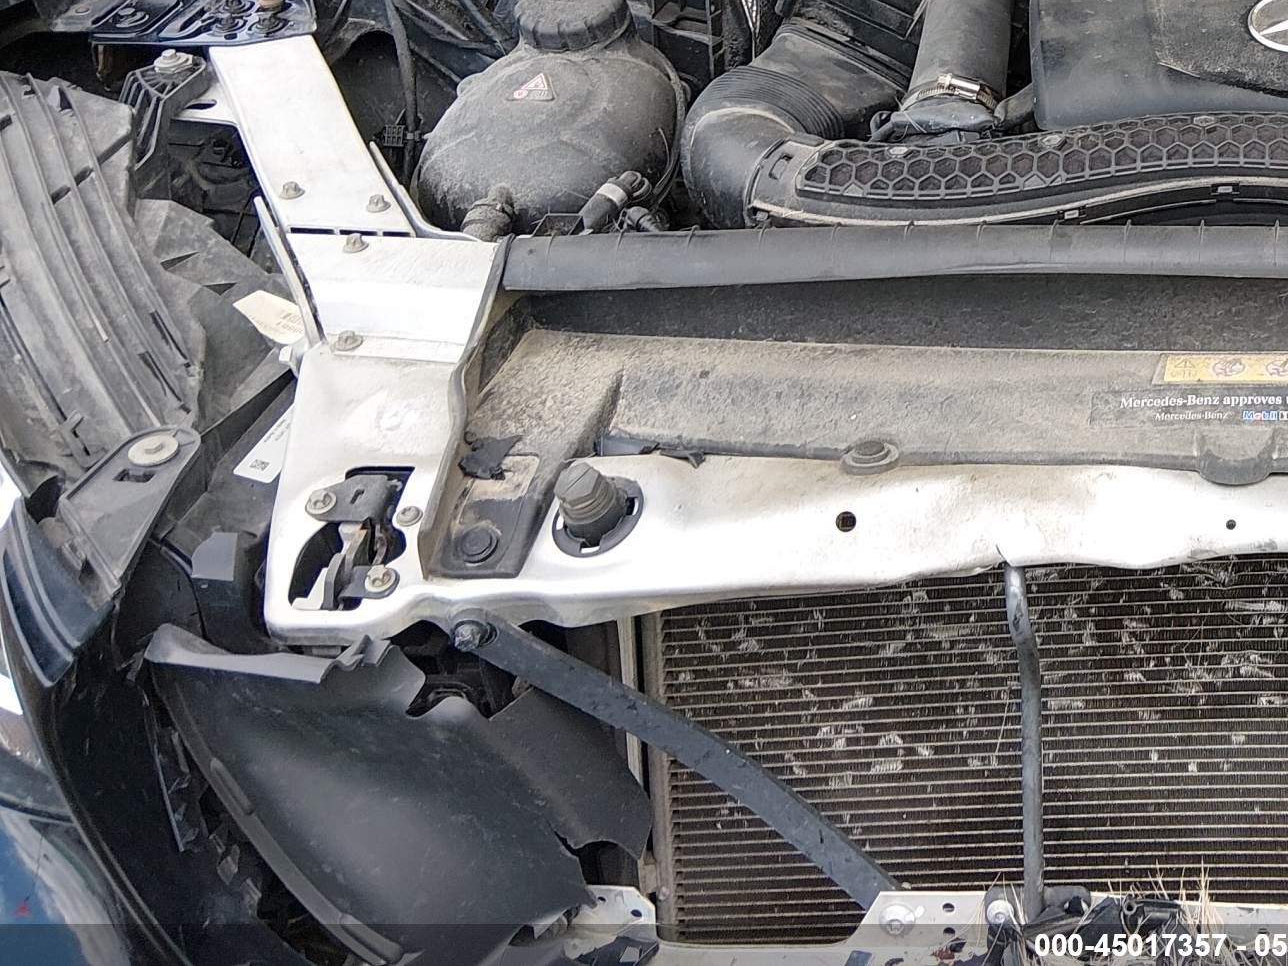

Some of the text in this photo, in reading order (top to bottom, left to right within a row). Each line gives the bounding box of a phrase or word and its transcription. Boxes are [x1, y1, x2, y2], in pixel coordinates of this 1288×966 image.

[1119, 394, 1220, 409] Mercedes-Benz
[1222, 394, 1282, 407] approves
[1154, 410, 1229, 421] Mercedes-Benz
